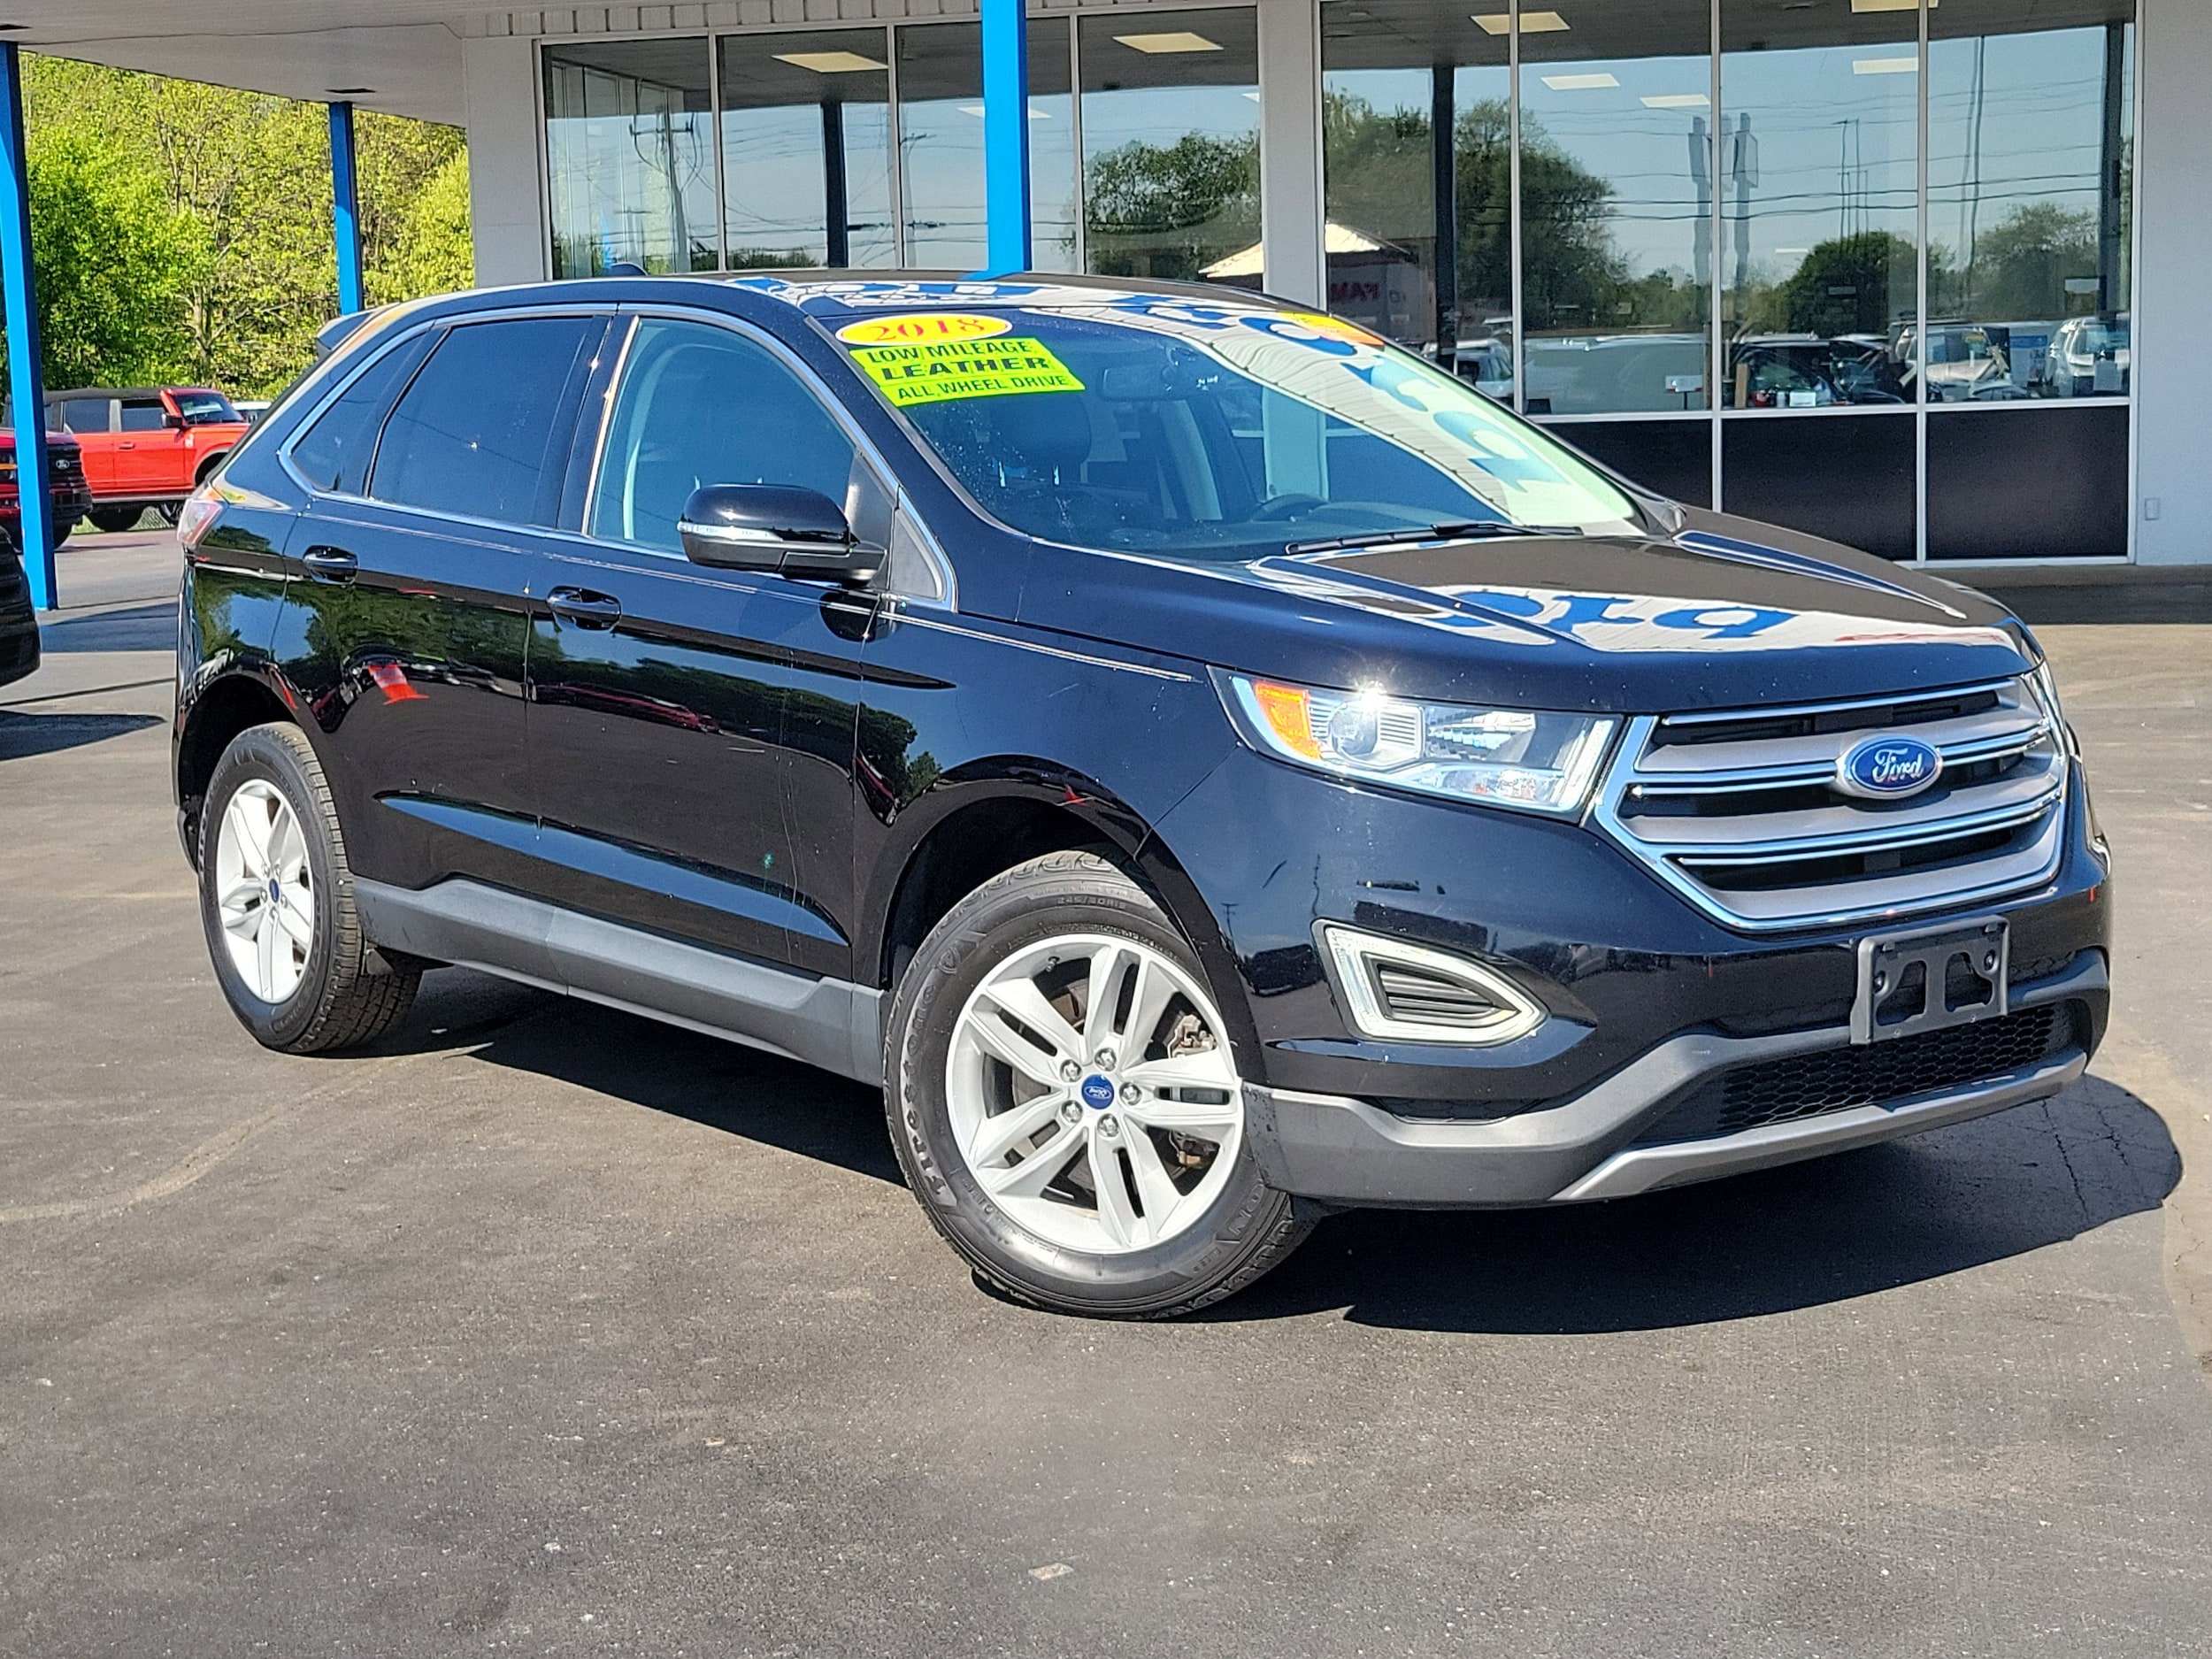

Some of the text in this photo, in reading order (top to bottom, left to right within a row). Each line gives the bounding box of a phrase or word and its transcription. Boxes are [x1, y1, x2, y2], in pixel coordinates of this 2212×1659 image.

[866, 319, 984, 342] 2018
[866, 342, 1032, 363] LOW MILEAGE
[881, 357, 1049, 380] LEATHER
[898, 375, 1069, 399] ALL WHEEL DRIVE
[1872, 748, 1924, 783] Ford
[902, 983, 946, 1194] Firestone
